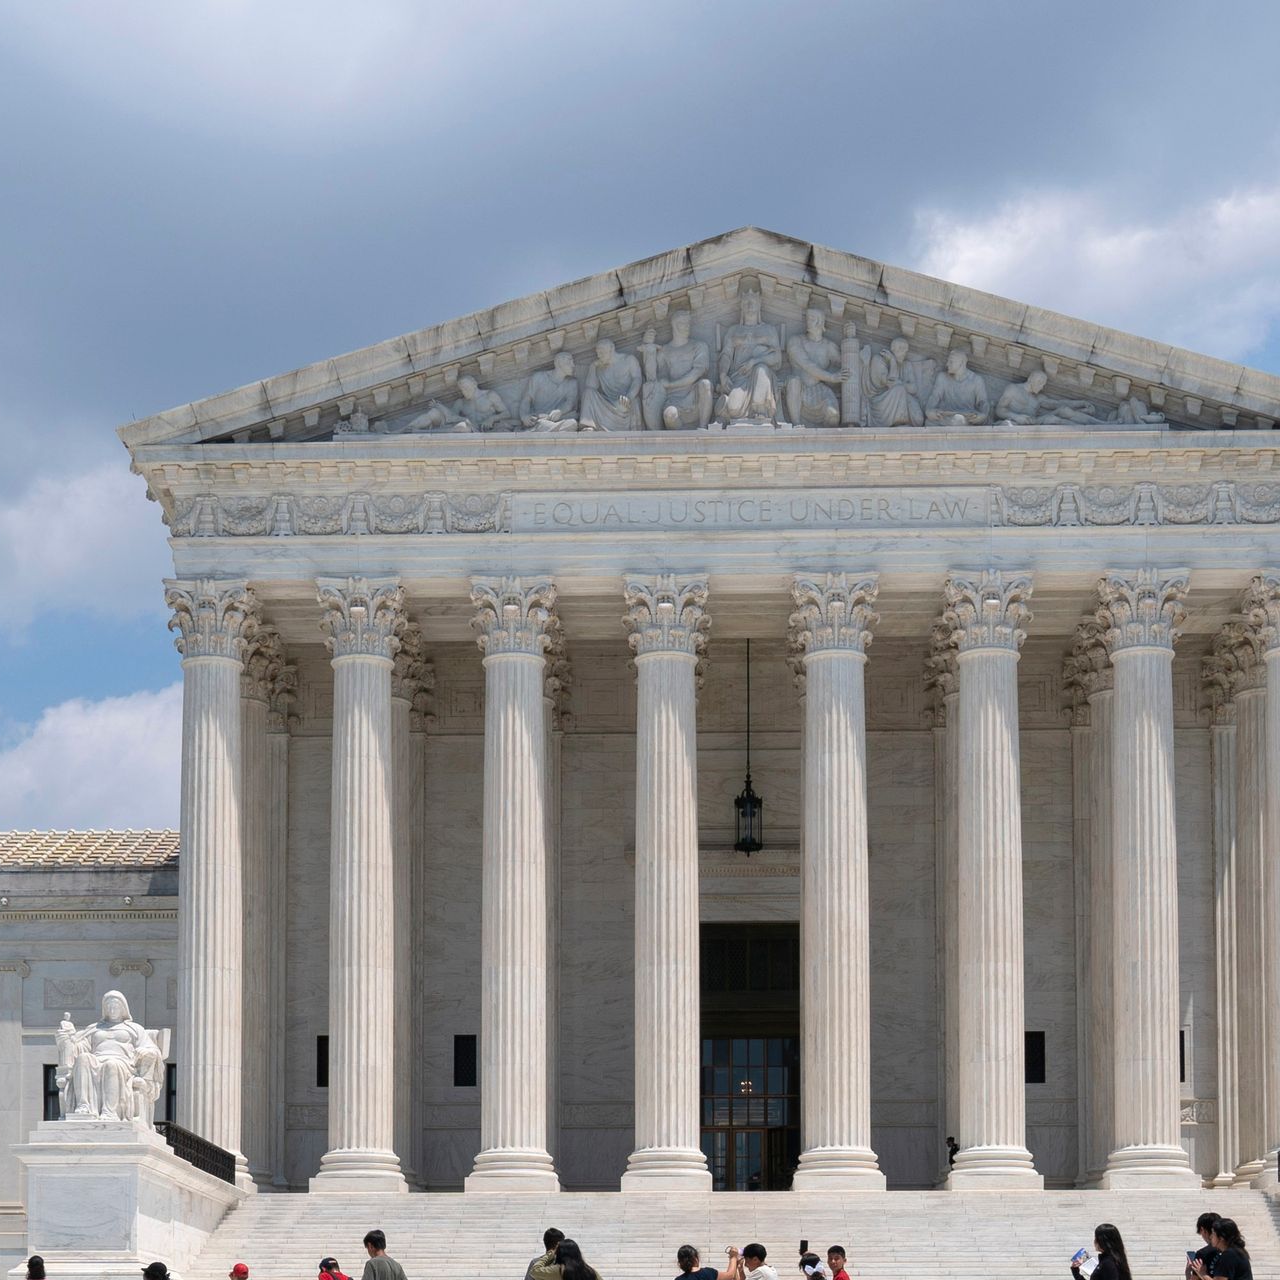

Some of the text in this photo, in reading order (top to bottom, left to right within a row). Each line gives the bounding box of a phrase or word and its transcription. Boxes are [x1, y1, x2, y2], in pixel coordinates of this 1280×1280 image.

[533, 497, 970, 527] EQUAL JUSTICE UNDER LAW
